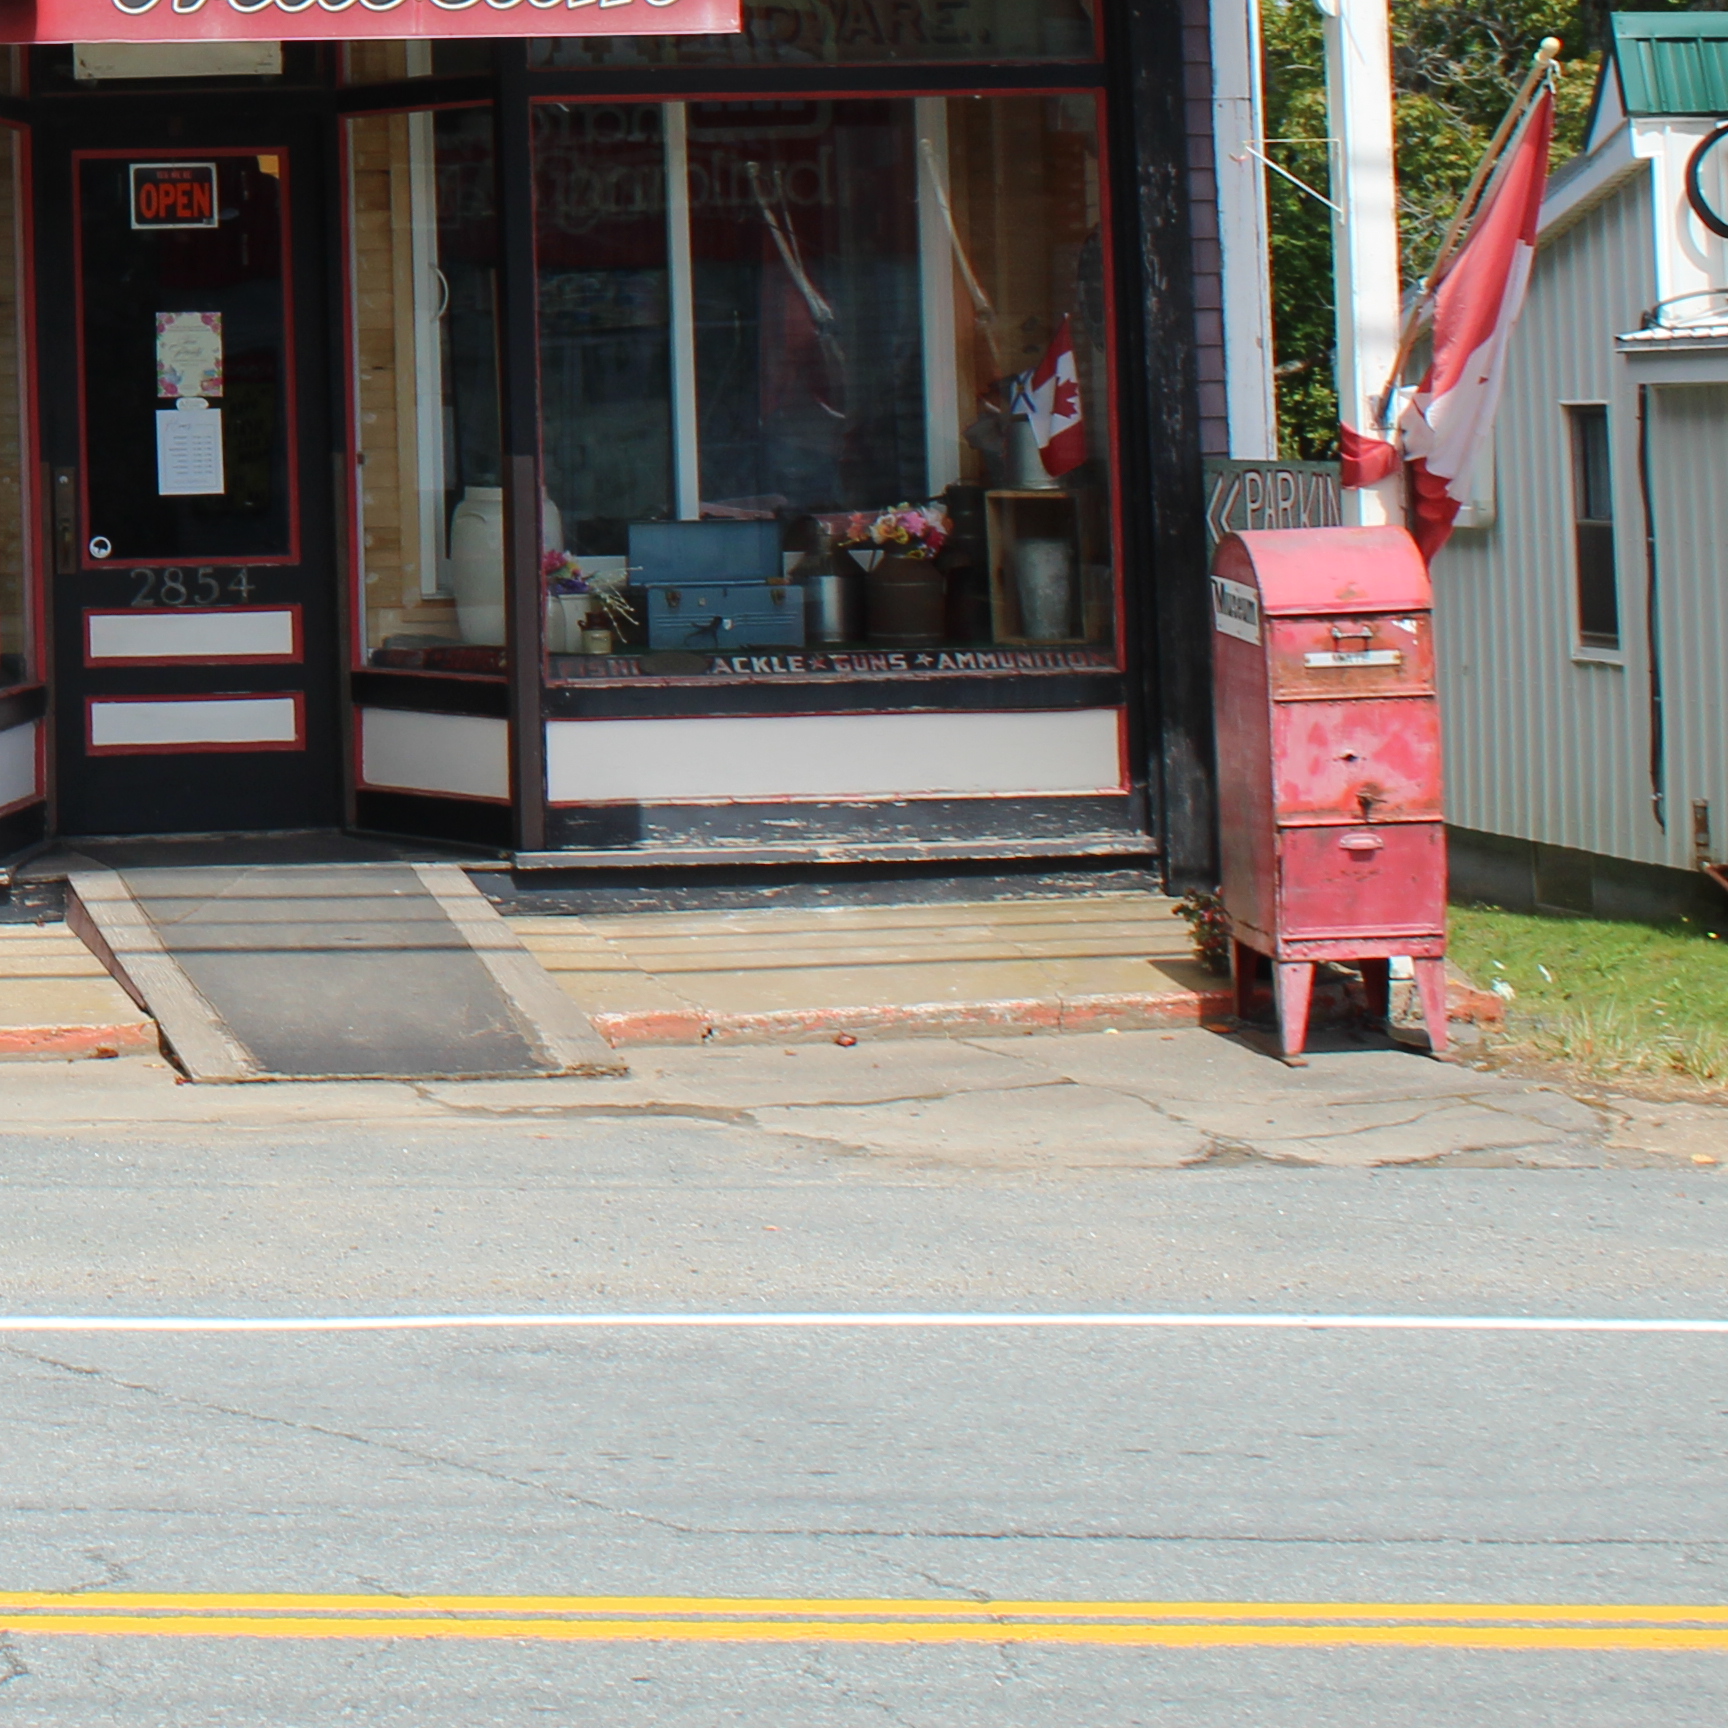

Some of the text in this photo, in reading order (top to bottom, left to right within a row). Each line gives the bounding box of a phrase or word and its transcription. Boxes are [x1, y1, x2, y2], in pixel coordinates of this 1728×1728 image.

[139, 182, 211, 219] OPEN
[1243, 469, 1342, 530] PARKIN
[130, 566, 256, 606] 2854
[708, 654, 806, 675] ACKLE
[831, 652, 909, 673] GUNS
[937, 651, 1114, 670] AMMUNITION
